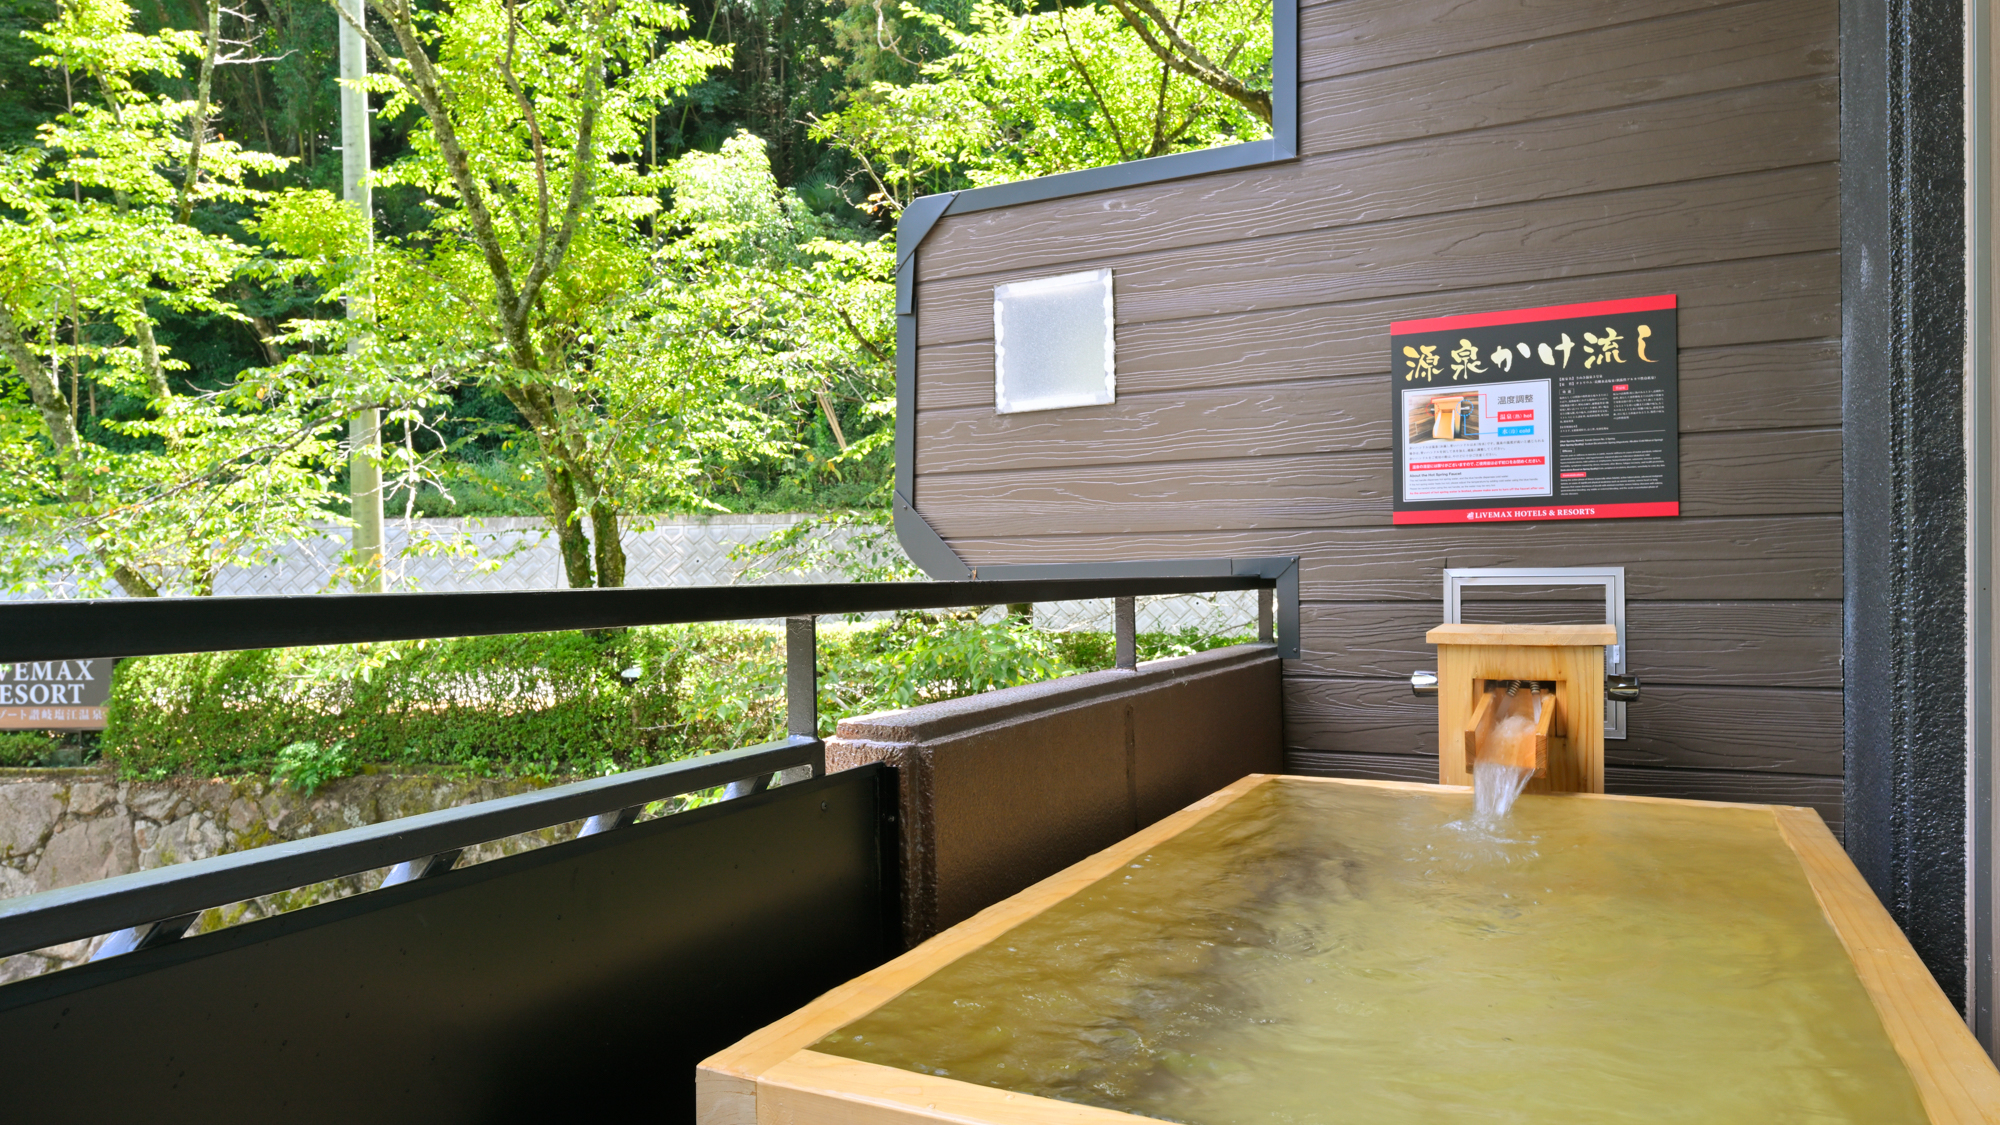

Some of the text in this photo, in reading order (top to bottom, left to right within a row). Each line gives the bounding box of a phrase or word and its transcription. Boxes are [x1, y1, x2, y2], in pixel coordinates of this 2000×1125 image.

[1403, 325, 1659, 382] 源泉かけ流し
[1497, 394, 1534, 405] 温度調整
[1514, 509, 1547, 518] HOTELS
[1557, 508, 1595, 516] RESORTS
[0, 683, 85, 705] ESORT
